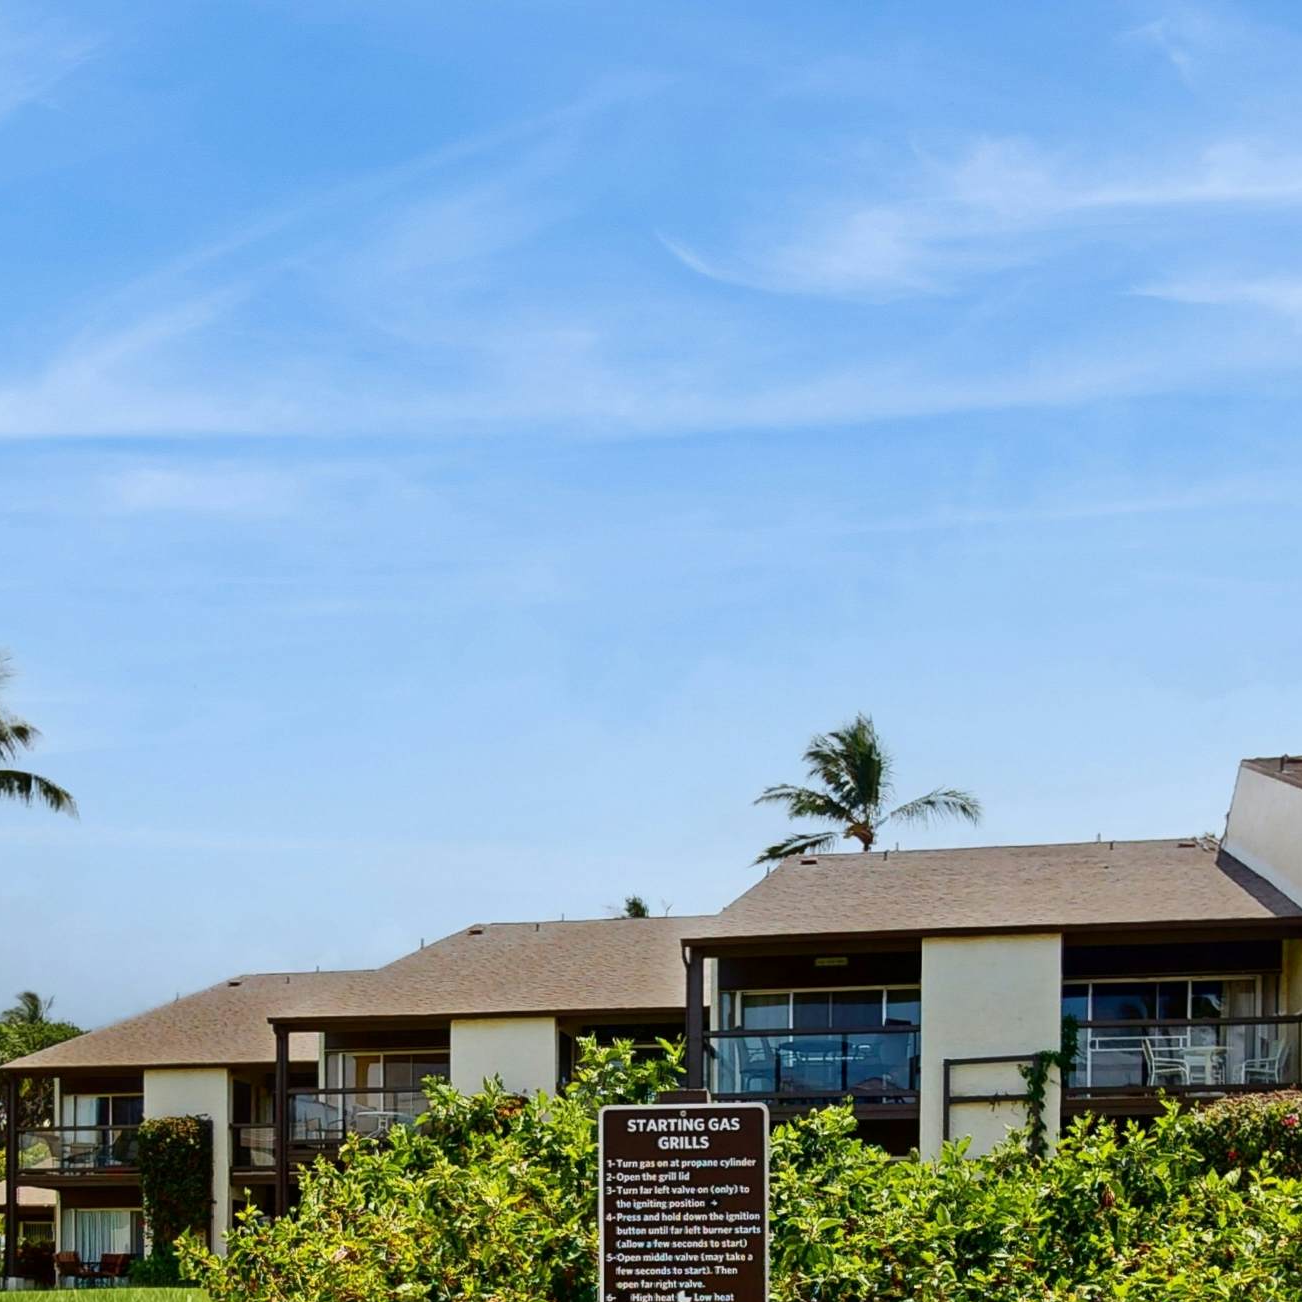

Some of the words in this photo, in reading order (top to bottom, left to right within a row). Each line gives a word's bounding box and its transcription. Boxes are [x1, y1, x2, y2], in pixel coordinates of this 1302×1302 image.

[627, 1118, 705, 1133] STARTING
[707, 1117, 740, 1132] GAS
[657, 1135, 710, 1150] GRILLS
[639, 1160, 656, 1170] gas
[656, 1160, 669, 1168] on
[669, 1159, 680, 1168] at
[681, 1159, 718, 1169] propane
[719, 1157, 756, 1169] cylinder
[641, 1172, 657, 1182] the
[658, 1171, 677, 1183] grill
[678, 1171, 690, 1181] lid
[639, 1185, 653, 1195] far
[654, 1185, 670, 1195] left
[671, 1185, 696, 1194] valve
[697, 1186, 709, 1194] on
[710, 1184, 739, 1195] (only)
[739, 1185, 750, 1194] to
[616, 1199, 632, 1209] the
[632, 1199, 668, 1210] igniting
[668, 1198, 706, 1209] position
[643, 1212, 660, 1222] and
[661, 1212, 682, 1221] hold
[682, 1212, 708, 1221] down
[708, 1211, 725, 1221] the
[725, 1211, 761, 1223] ignition
[616, 1226, 647, 1236] button
[647, 1225, 669, 1235] until
[670, 1225, 683, 1235] far
[684, 1225, 701, 1235] left
[702, 1225, 733, 1235] burner
[734, 1225, 761, 1234] starts
[616, 1239, 645, 1249] (allow
[646, 1241, 652, 1249] a
[652, 1239, 670, 1248] few
[672, 1239, 709, 1248] seconds
[709, 1239, 720, 1248] to
[721, 1238, 748, 1248] start)
[642, 1252, 673, 1262] middle
[674, 1252, 699, 1262] valve
[700, 1252, 724, 1263] (may
[725, 1251, 746, 1262] take
[747, 1253, 754, 1261] a
[615, 1266, 634, 1276] few
[634, 1266, 672, 1276] seconds
[672, 1266, 683, 1275] to
[714, 1265, 738, 1275] Then
[616, 1281, 639, 1290] open
[640, 1279, 653, 1289] far
[655, 1279, 677, 1291] right
[655, 1292, 675, 1302] heat
[693, 1292, 713, 1302] Low
[714, 1292, 735, 1302] heat
